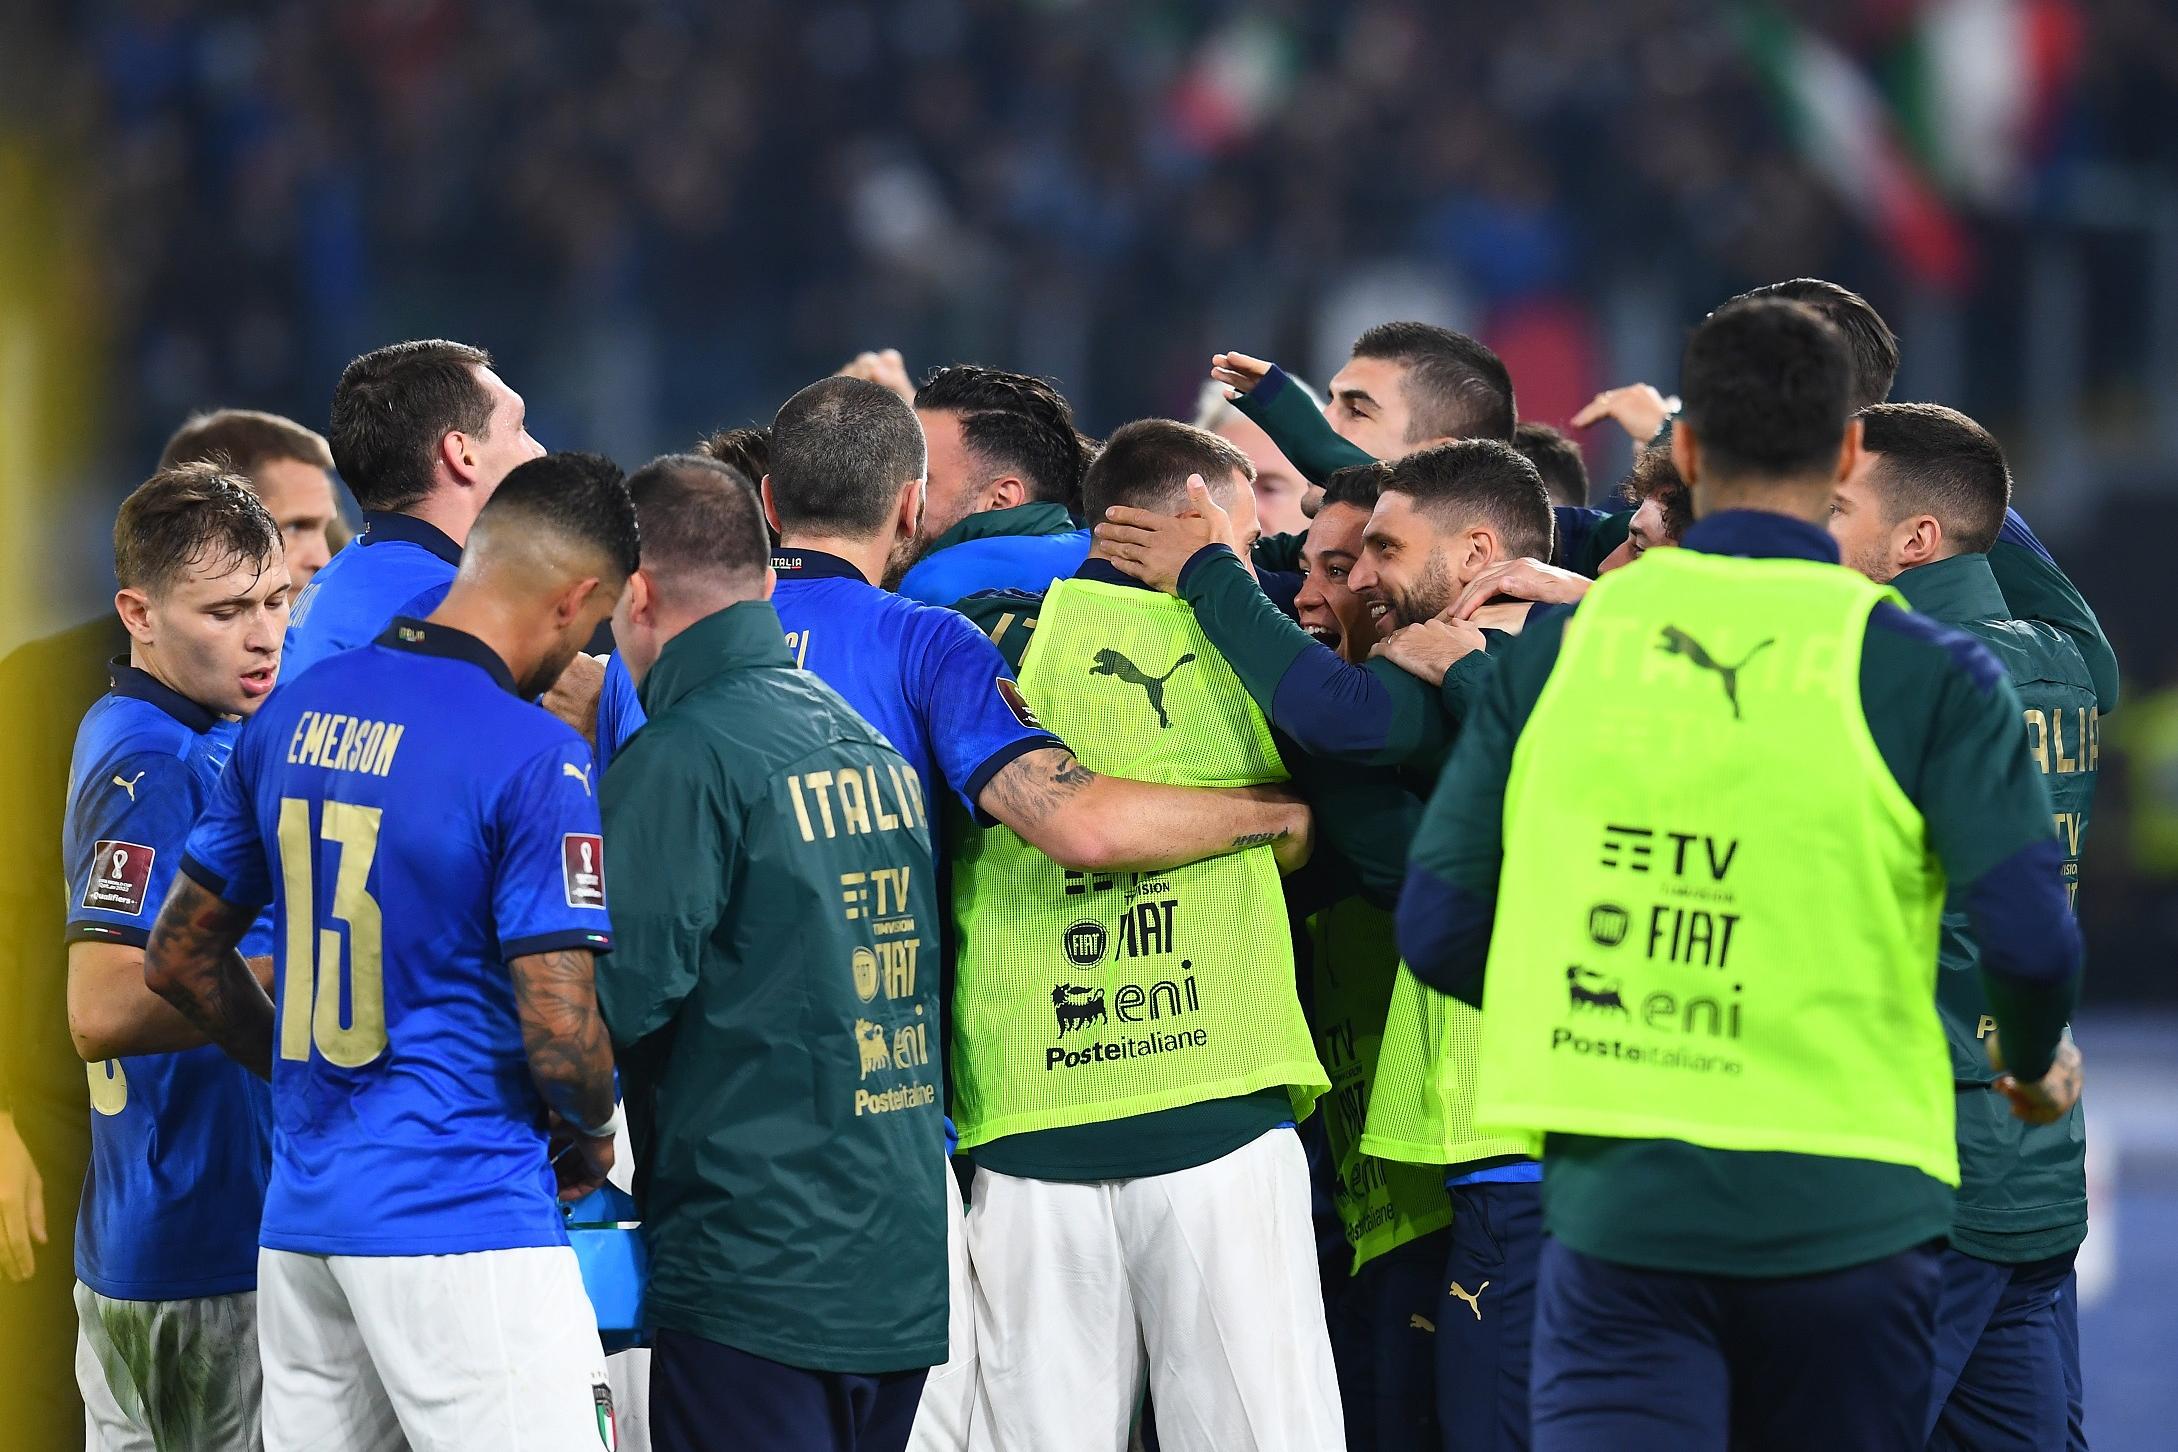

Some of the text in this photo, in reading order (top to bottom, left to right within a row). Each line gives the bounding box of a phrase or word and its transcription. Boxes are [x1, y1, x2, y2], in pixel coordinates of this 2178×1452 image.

[771, 557, 802, 567] ITALIA
[287, 711, 405, 777] EMERSON
[2024, 705, 2098, 774] ALIA
[787, 765, 928, 842] ITALIA
[1667, 832, 1738, 880] TV
[93, 891, 131, 904] Qualifiers
[870, 866, 910, 915] TV
[278, 797, 390, 1068] 13
[1071, 932, 1100, 958] FIAT
[1648, 904, 1741, 970] FIAT
[1114, 959, 1200, 1023] eni
[1641, 979, 1743, 1039] eni
[893, 1004, 929, 1070] eni
[1046, 1028, 1208, 1071] Posteitaliane
[1326, 1017, 1356, 1067] TV
